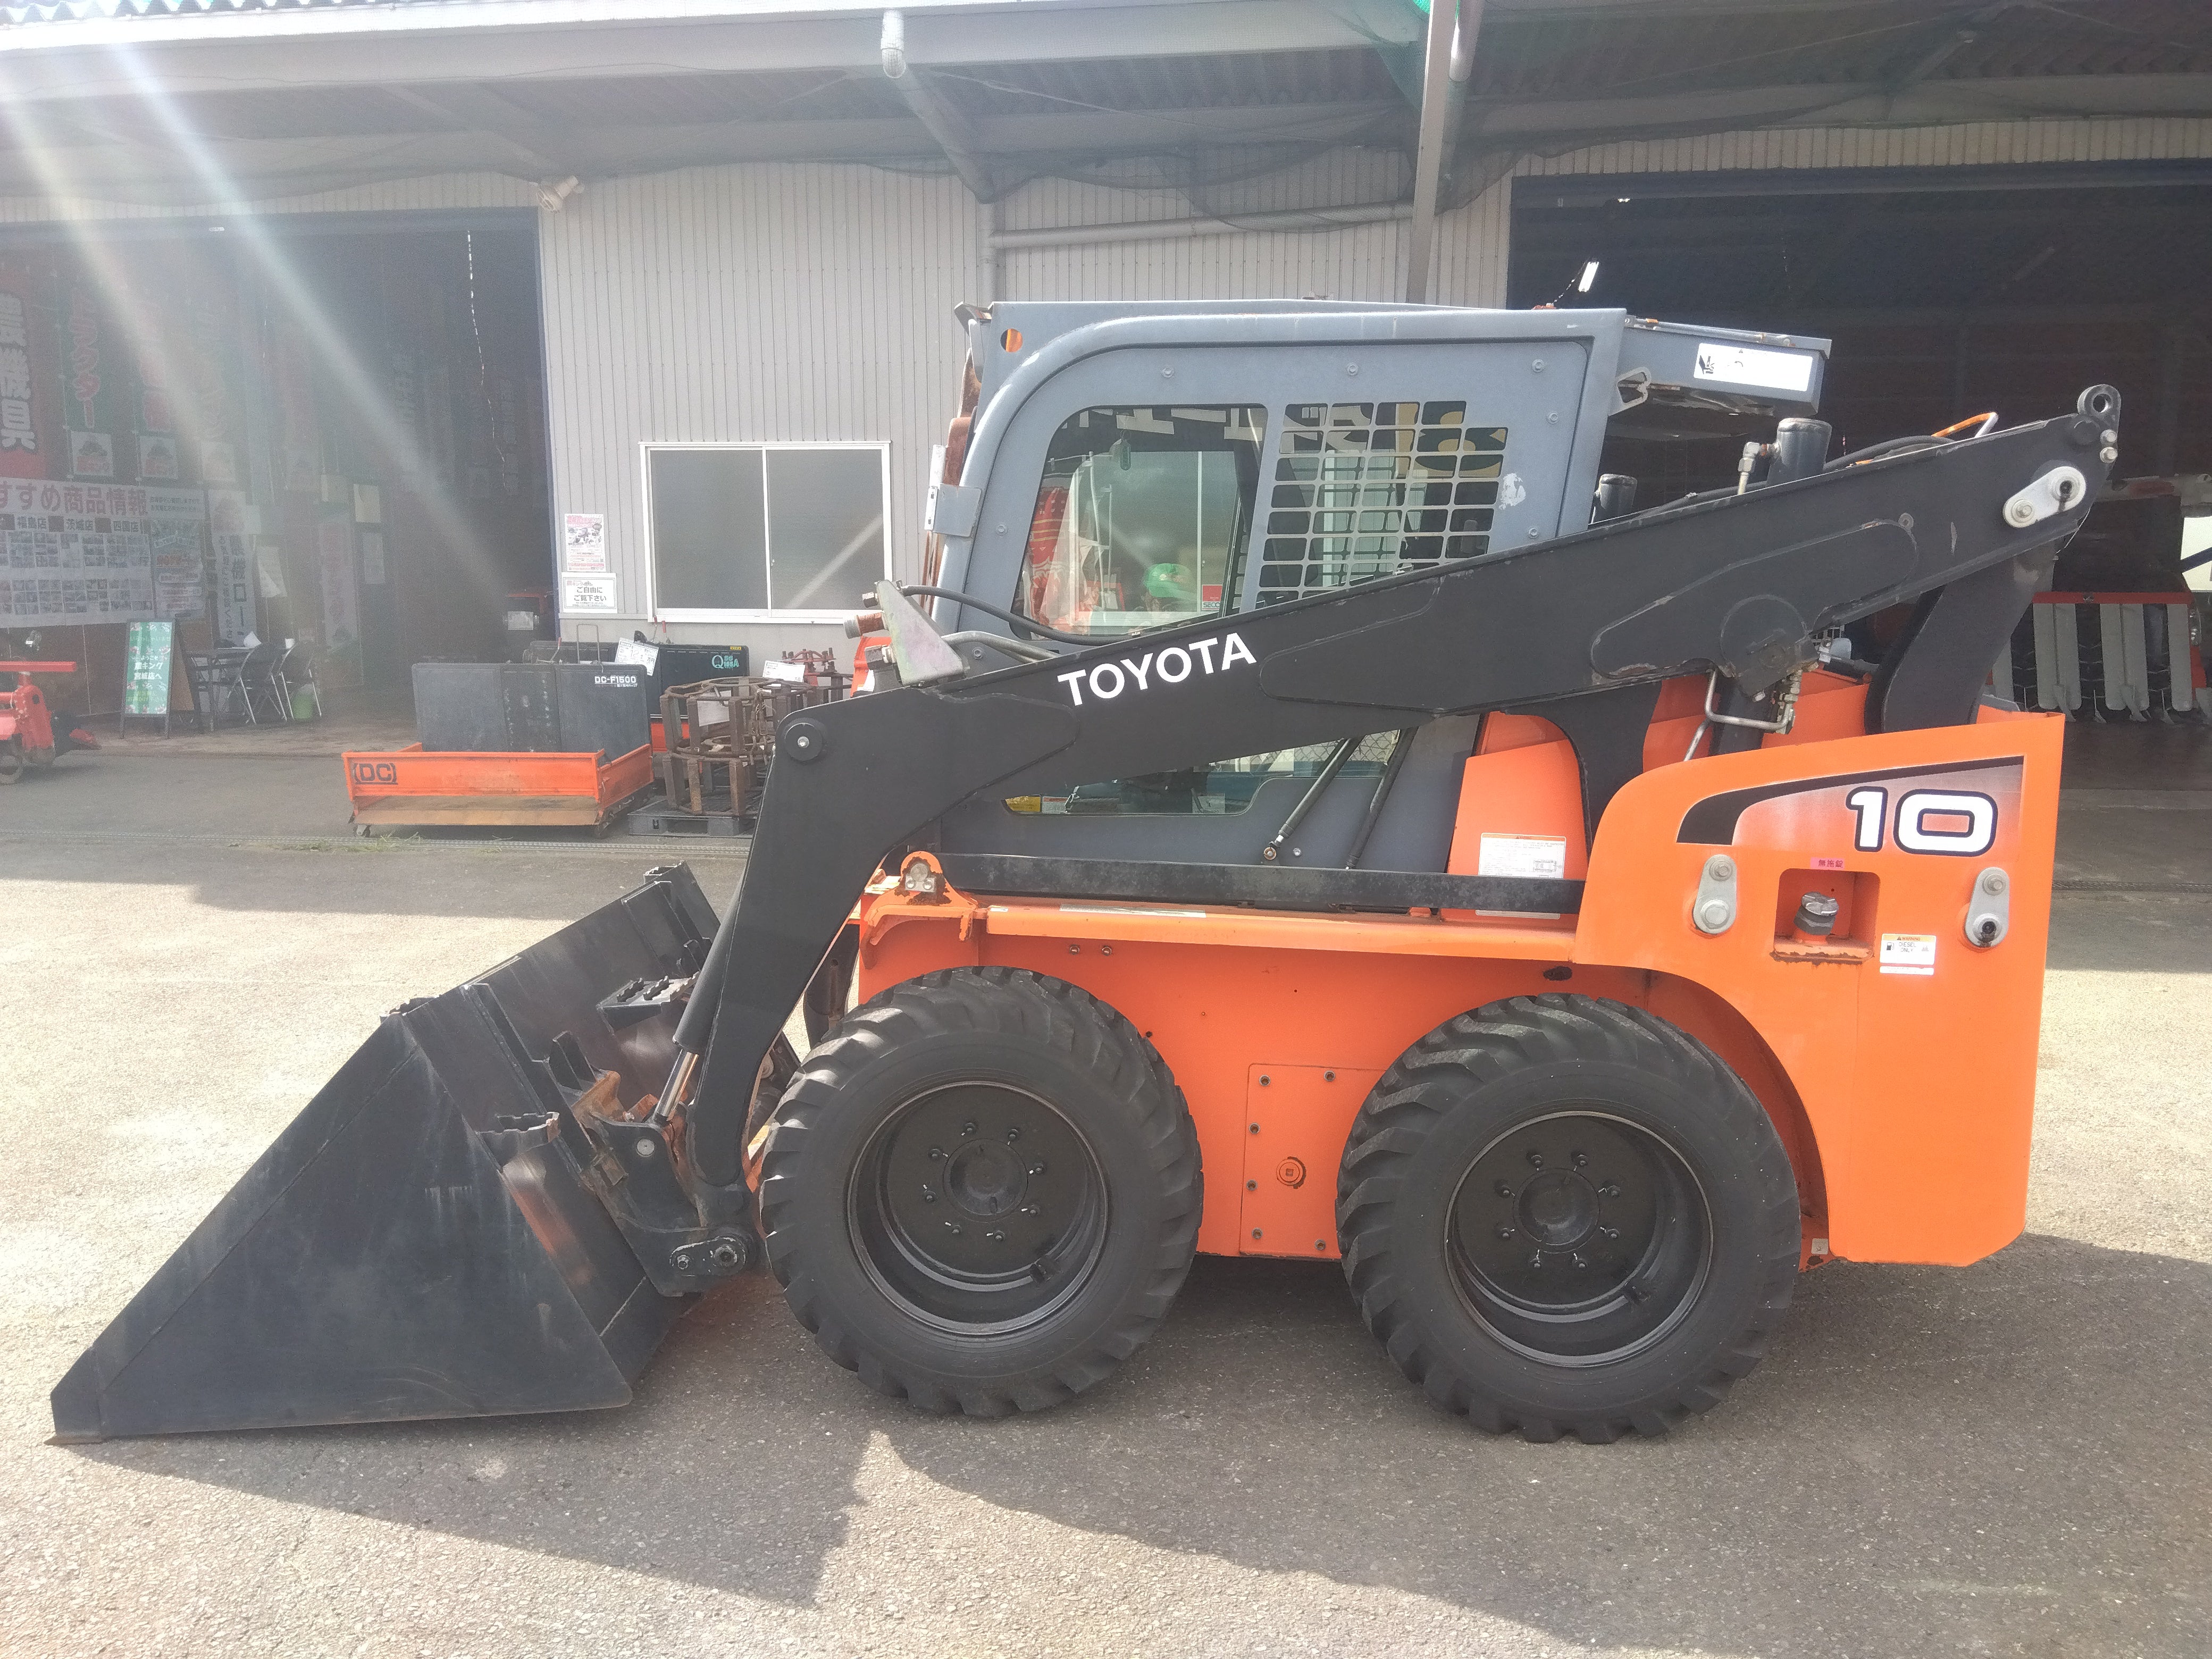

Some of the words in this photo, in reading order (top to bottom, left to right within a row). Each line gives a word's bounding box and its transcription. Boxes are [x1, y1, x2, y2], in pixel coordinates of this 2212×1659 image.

[18, 516, 47, 530] 福島店
[229, 535, 247, 635] 農機ロー
[1057, 633, 1256, 706] TOYOTA
[1846, 785, 1998, 857] 10
[1818, 859, 1844, 868] 無施錠
